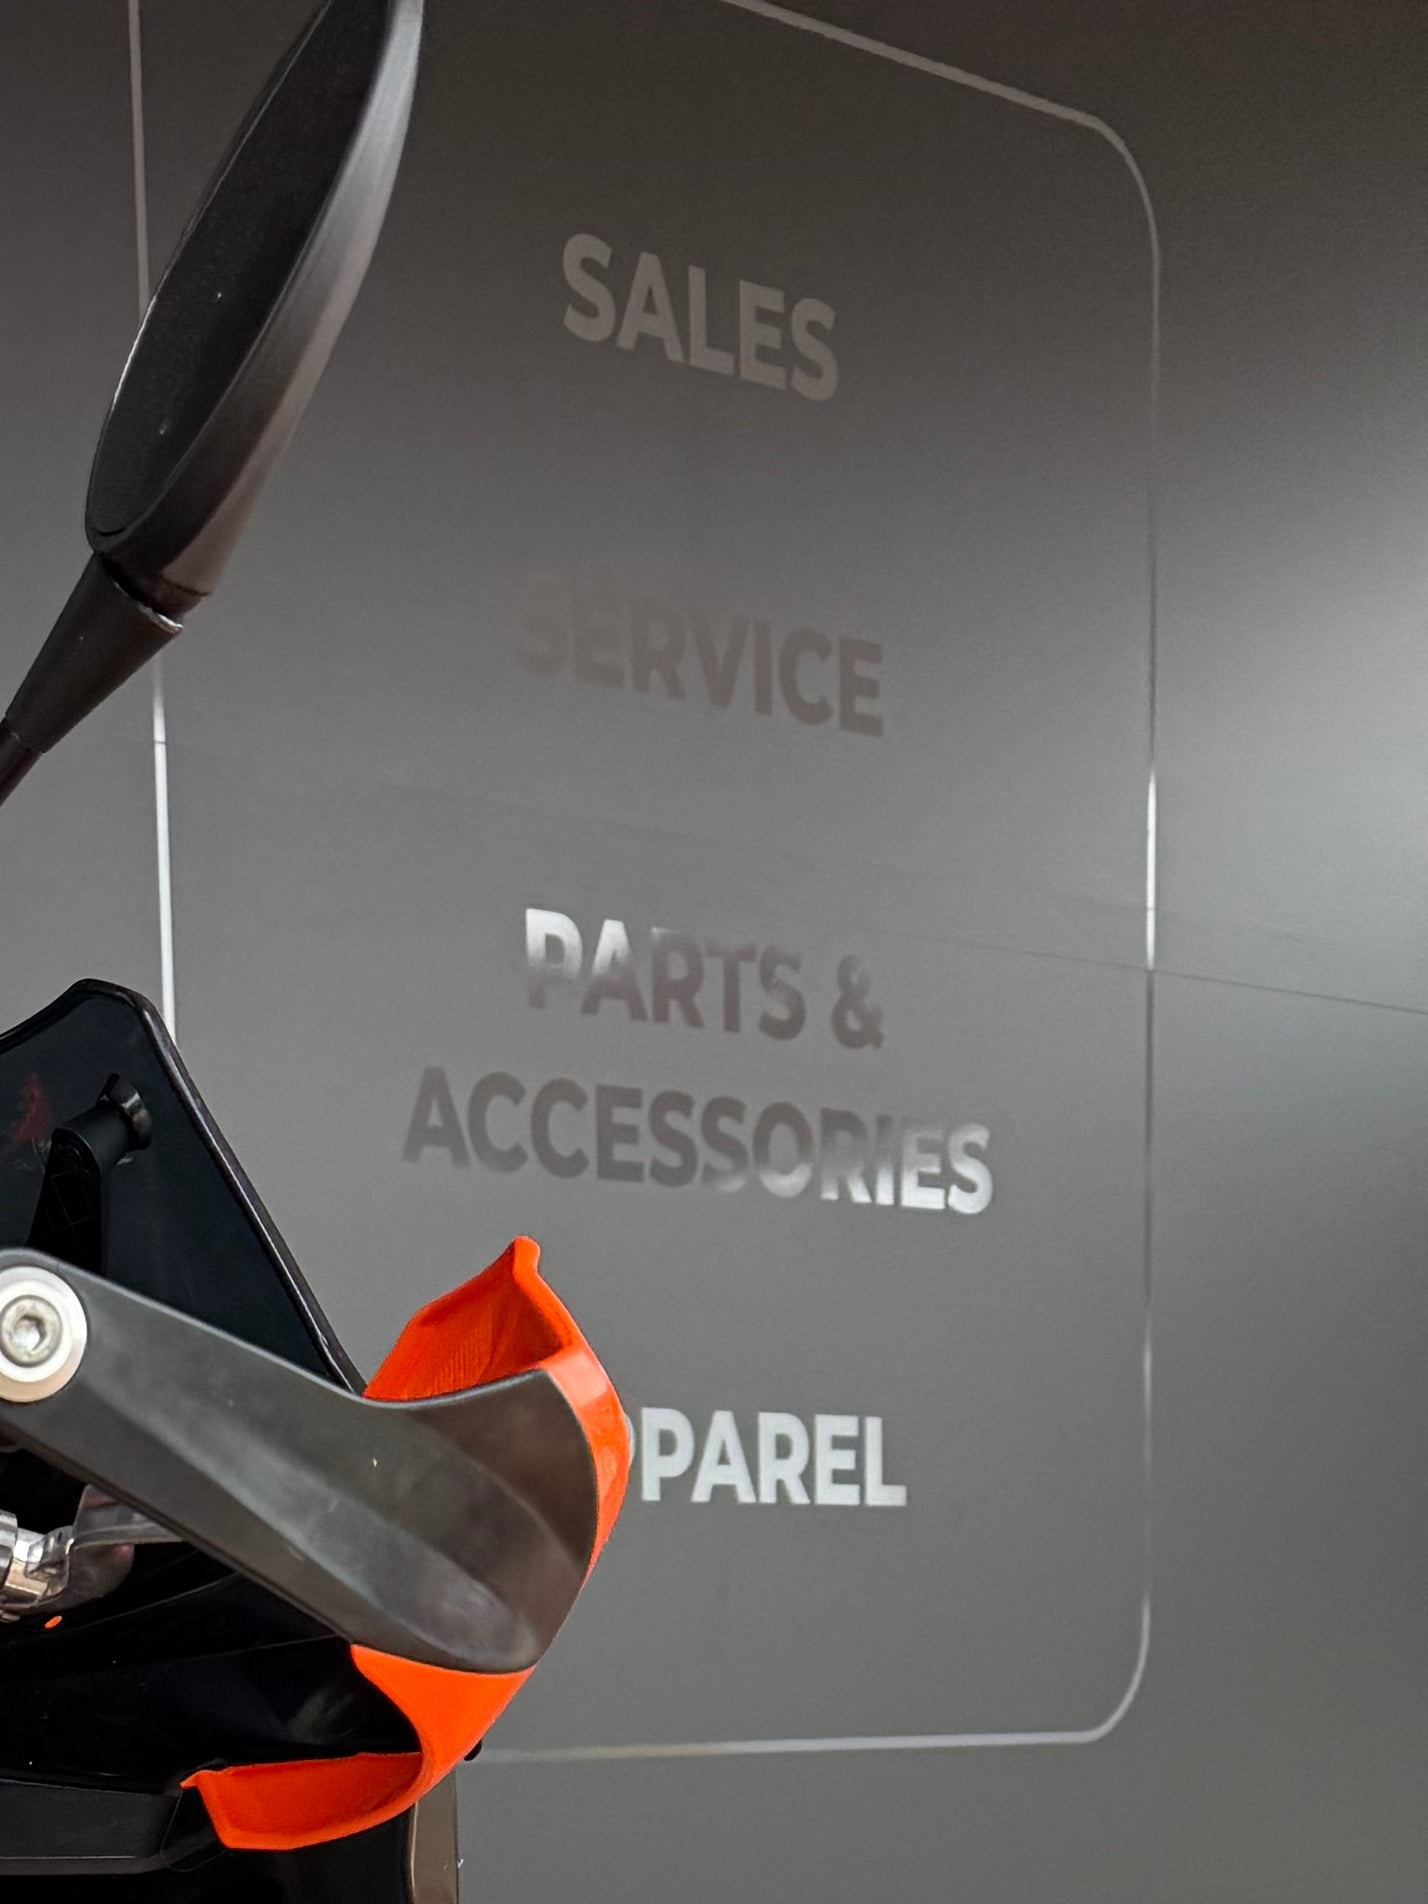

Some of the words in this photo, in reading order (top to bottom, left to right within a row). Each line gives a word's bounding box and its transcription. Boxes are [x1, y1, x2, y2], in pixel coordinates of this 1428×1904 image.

[562, 232, 838, 401] SALES
[516, 570, 885, 738] SERVICE
[524, 906, 806, 1042] PARTS
[831, 952, 885, 1050] &
[402, 1066, 995, 1216] ACCESSORIES
[628, 1405, 908, 1508] PAREL
